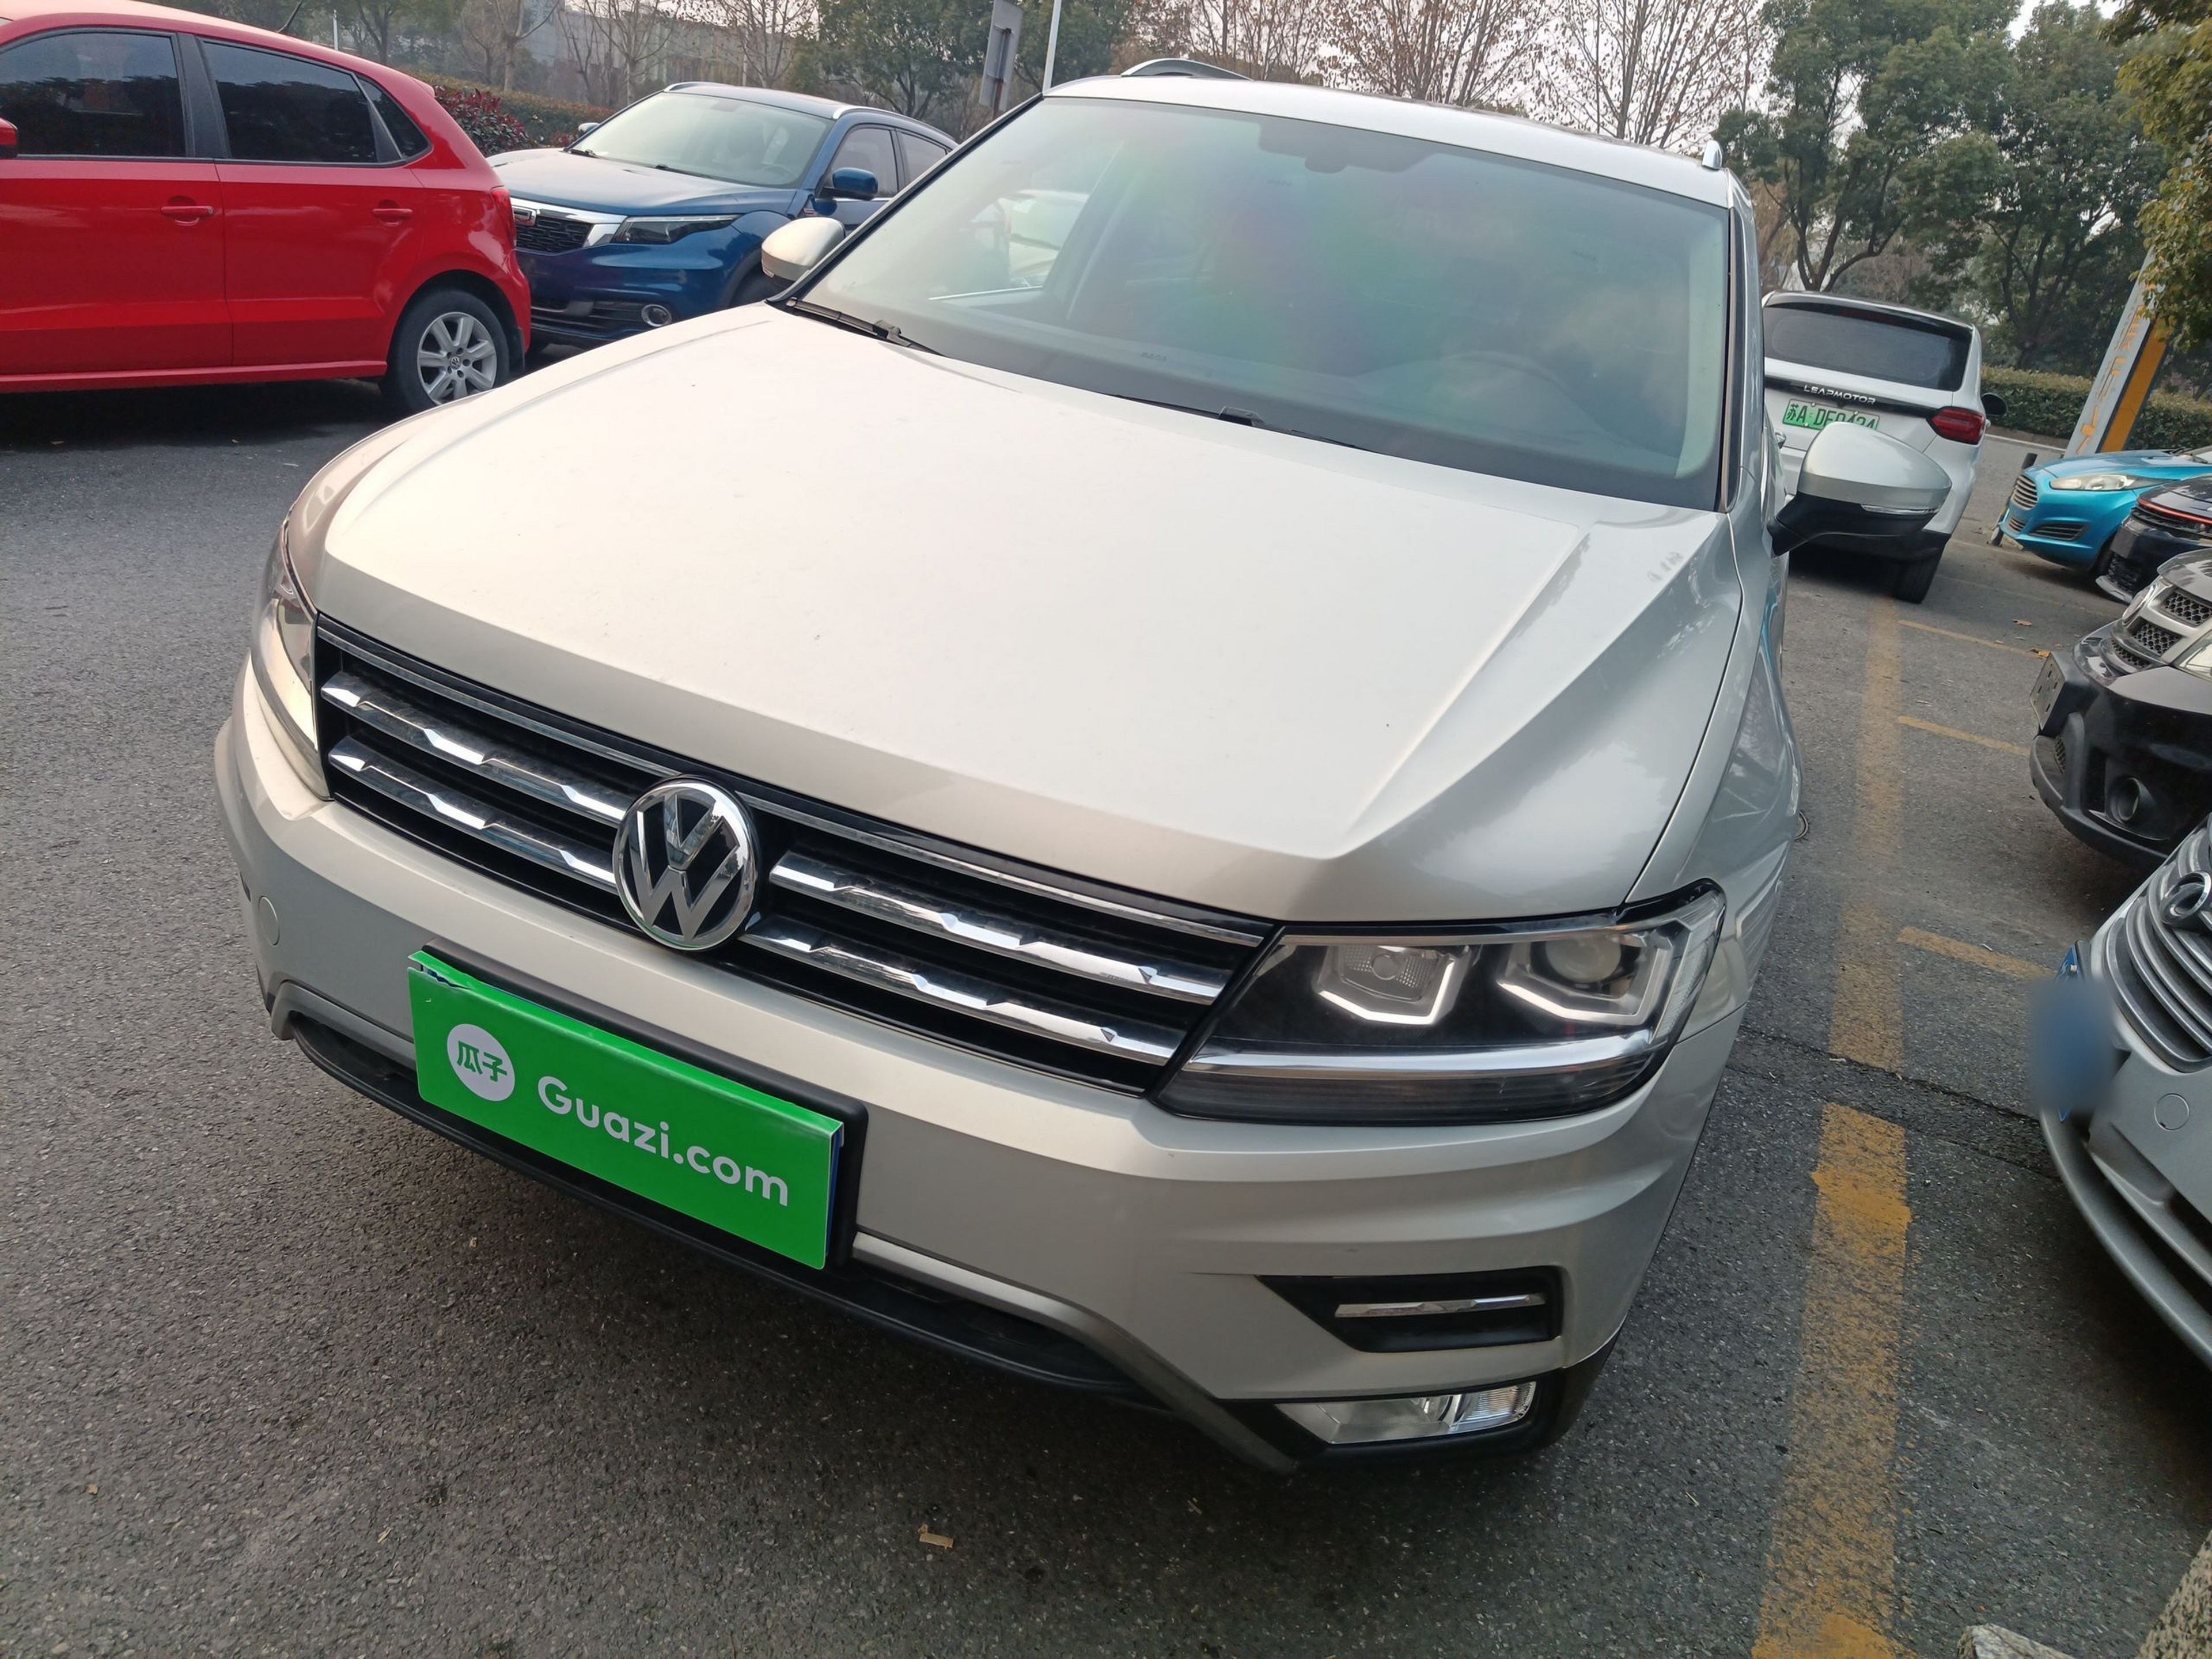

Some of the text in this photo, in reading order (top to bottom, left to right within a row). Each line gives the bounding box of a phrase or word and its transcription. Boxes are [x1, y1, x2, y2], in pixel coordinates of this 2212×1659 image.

[1804, 384, 1876, 404] LEAPMOTOR
[626, 791, 745, 942] VW
[457, 1040, 508, 1082] 瓜子
[537, 1075, 788, 1207] Guazi.com
